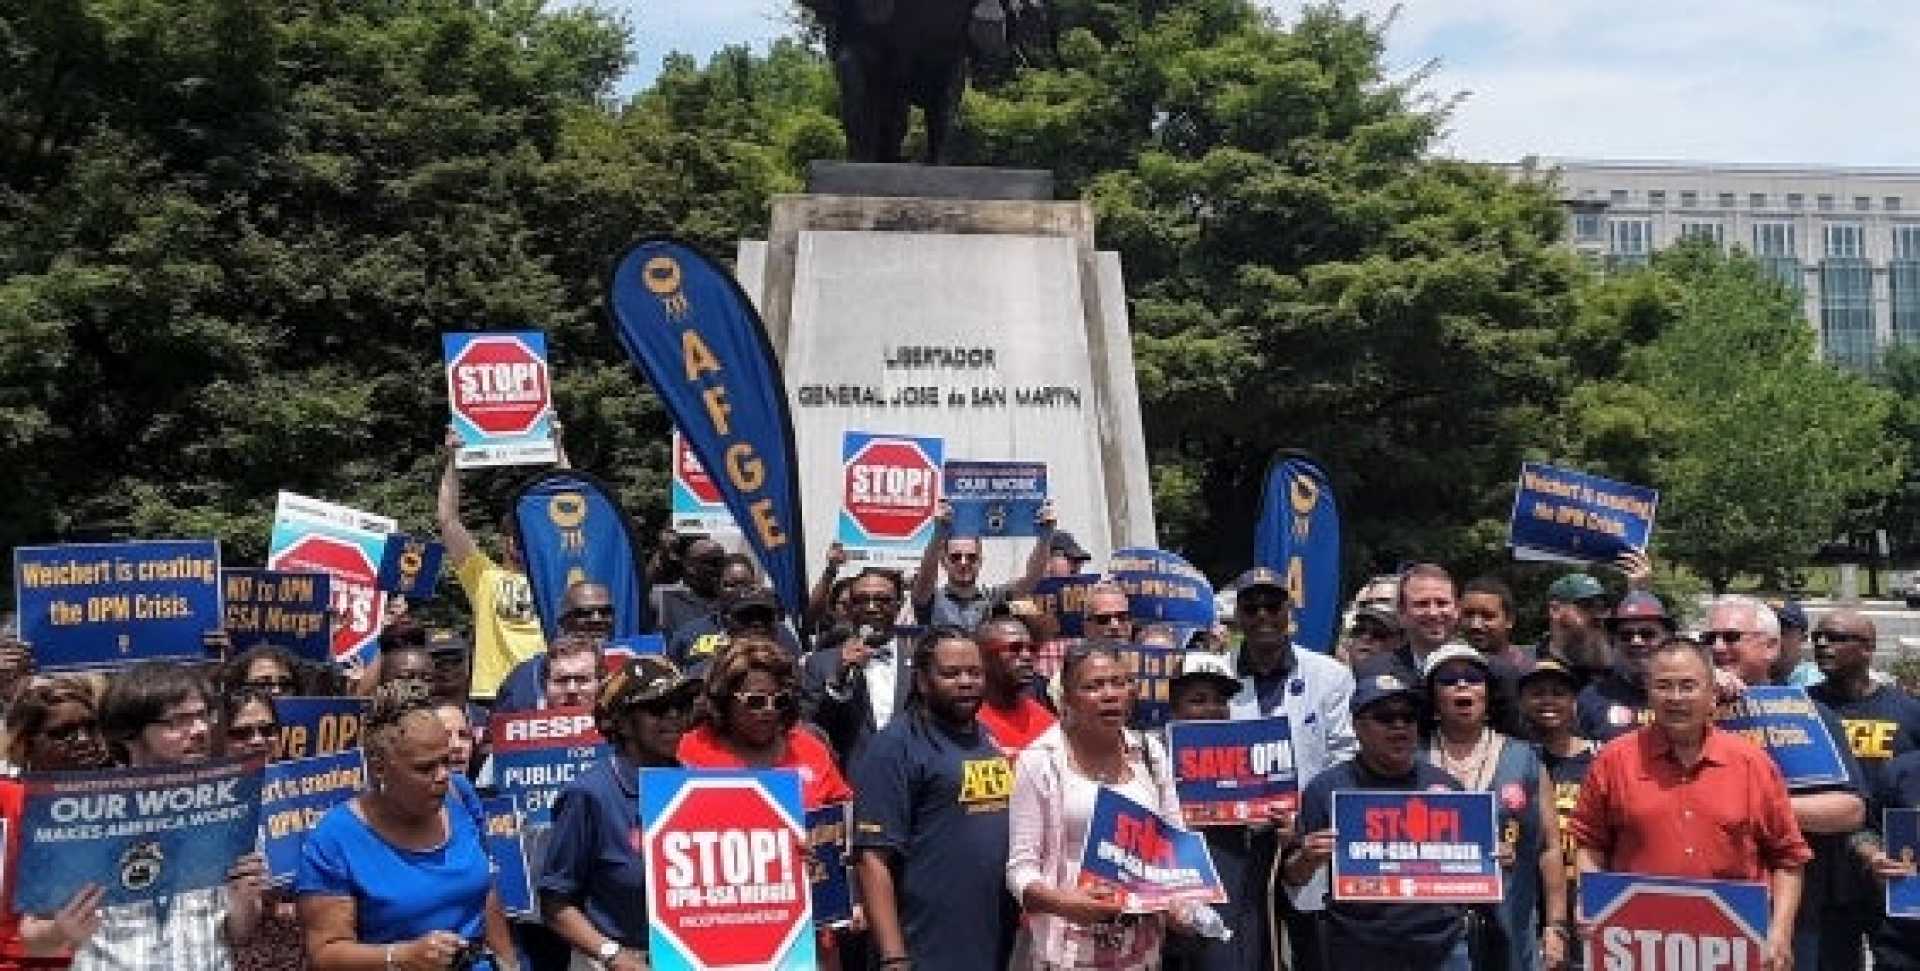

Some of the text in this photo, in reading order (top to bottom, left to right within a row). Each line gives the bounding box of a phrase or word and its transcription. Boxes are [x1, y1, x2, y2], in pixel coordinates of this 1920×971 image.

[884, 348, 996, 369] LIBERTADOR
[458, 363, 538, 393] STOP!
[798, 387, 886, 408] GENERAL
[889, 387, 938, 408] JOSE
[971, 387, 1007, 408] SAN
[1015, 388, 1081, 409] MARTIN
[682, 328, 786, 549] AFGE
[852, 466, 931, 497] STOP!
[23, 554, 215, 588] Weichert is creating
[227, 577, 313, 601] NO to OPM
[50, 594, 194, 625] the OPM Crisis.
[265, 607, 324, 638] Merger
[505, 715, 597, 741] RESP
[505, 762, 575, 788] PUBLIC
[1178, 739, 1292, 781] SAVE OPM
[50, 794, 128, 823] OUR
[136, 778, 240, 816] WORK
[33, 825, 103, 843] MAKES
[106, 814, 186, 838] AMERICA
[662, 828, 793, 887] STOP!
[1601, 926, 1747, 971] STOP!
